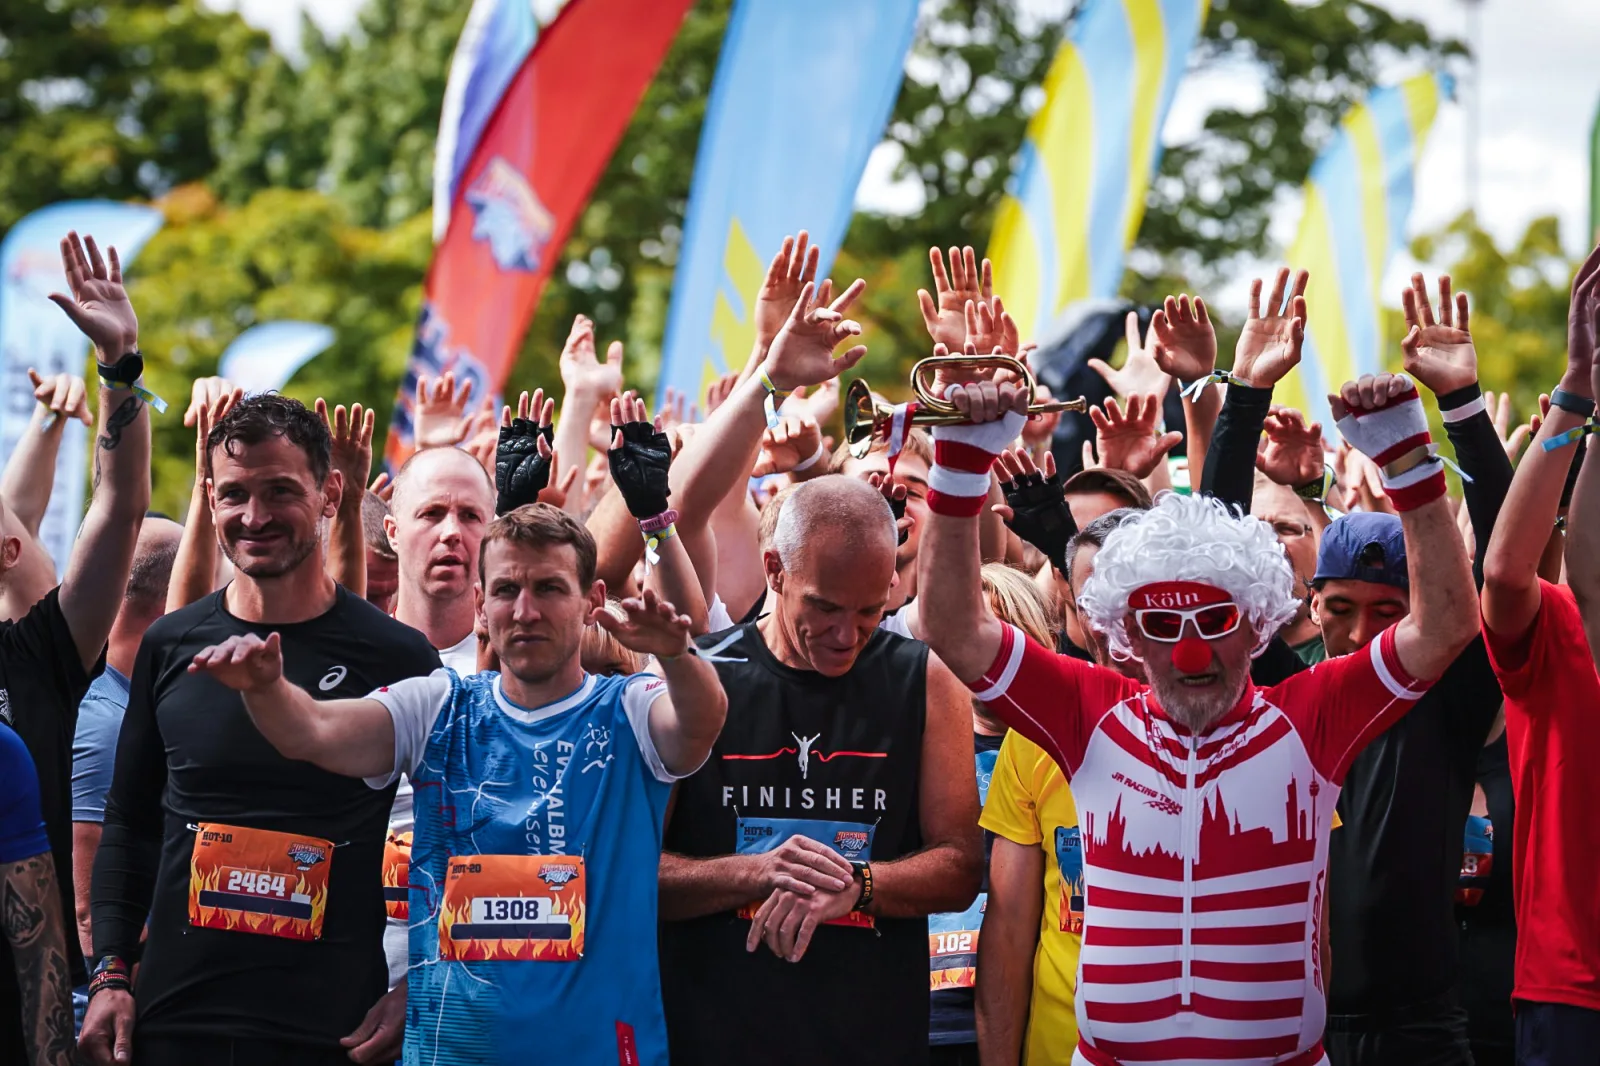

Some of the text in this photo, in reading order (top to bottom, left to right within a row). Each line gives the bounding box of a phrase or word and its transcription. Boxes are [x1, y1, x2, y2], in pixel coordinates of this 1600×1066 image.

[1144, 592, 1200, 608] Köln
[1124, 774, 1158, 798] RACING
[722, 785, 886, 810] FINISHER
[203, 831, 232, 843] HOT-10
[744, 826, 773, 836] HOT-6
[452, 863, 481, 874] HOT-20
[227, 870, 285, 897] 2464
[483, 900, 539, 920] 1308
[936, 933, 972, 953] 102
